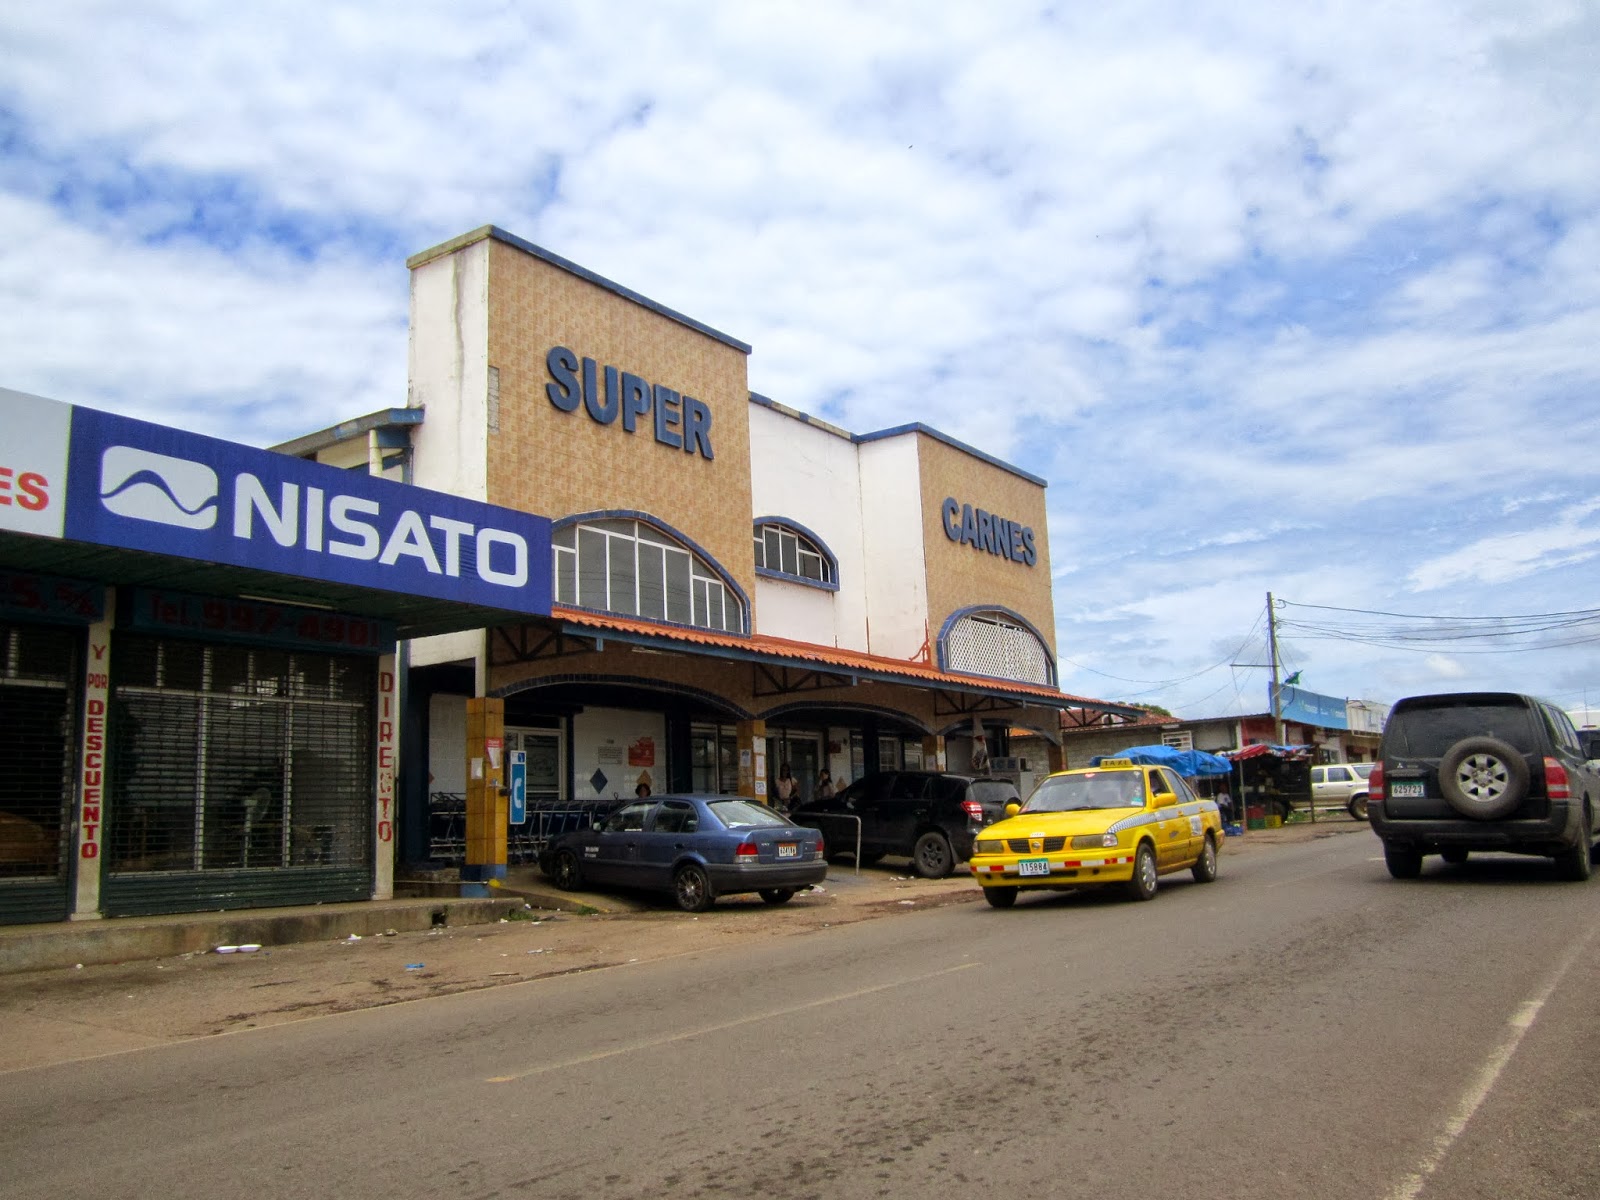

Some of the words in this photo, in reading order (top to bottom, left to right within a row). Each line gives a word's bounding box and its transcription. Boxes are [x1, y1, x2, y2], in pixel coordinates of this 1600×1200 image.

[545, 346, 714, 460] SUPER
[233, 472, 529, 588] NISATO
[942, 497, 1037, 566] CARNES
[92, 644, 107, 660] Y
[87, 673, 108, 690] POR
[377, 672, 394, 842] DIRECTO
[1103, 759, 1127, 767] TAXI
[81, 700, 105, 859] DESCUENTO
[1393, 785, 1422, 794] 625723
[1020, 862, 1047, 872] 115884
